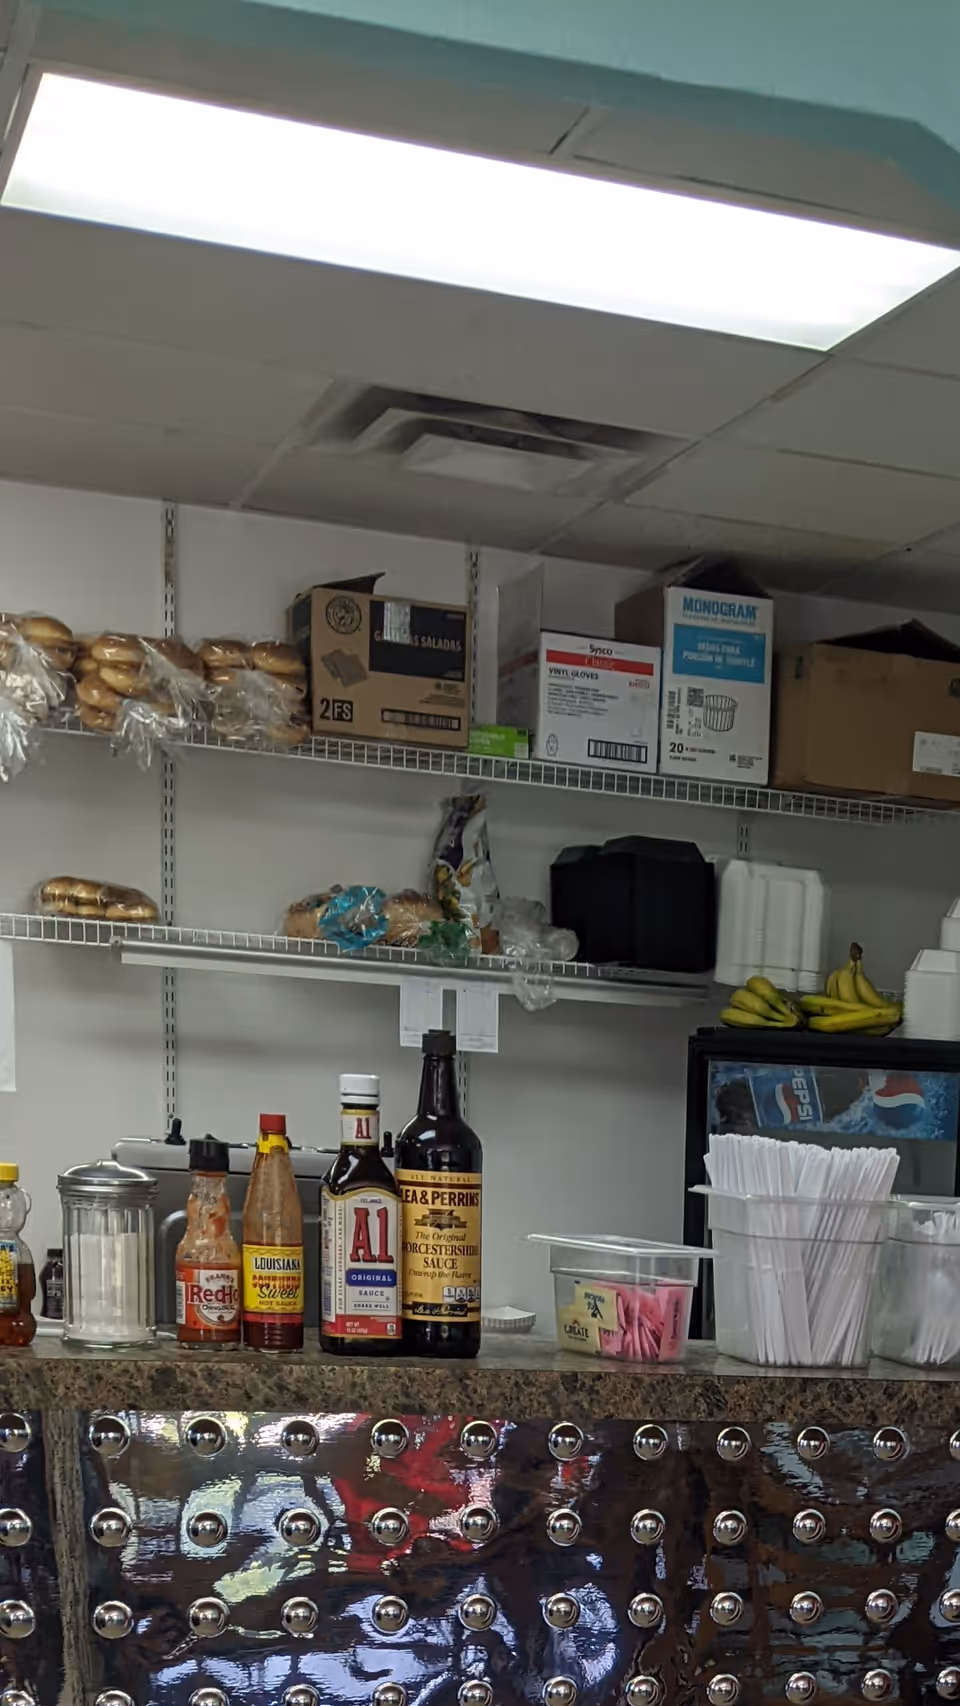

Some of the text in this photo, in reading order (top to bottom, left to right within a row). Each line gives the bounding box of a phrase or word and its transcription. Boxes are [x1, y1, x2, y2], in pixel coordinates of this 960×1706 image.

[682, 595, 757, 620] MONOGRAM
[589, 644, 613, 656] Sysco
[548, 667, 600, 681] VINYL GLOVES
[670, 742, 684, 754] 20
[355, 1118, 371, 1139] A1
[431, 1175, 472, 1183] NATURAL
[431, 1191, 479, 1207] PERRINS
[349, 1206, 394, 1263] A1
[415, 1231, 467, 1243] The Original
[423, 1257, 458, 1270] SAUCE
[351, 1273, 392, 1282] ORIGINAL
[438, 1270, 450, 1278] the
[257, 1285, 300, 1299] Sweet
